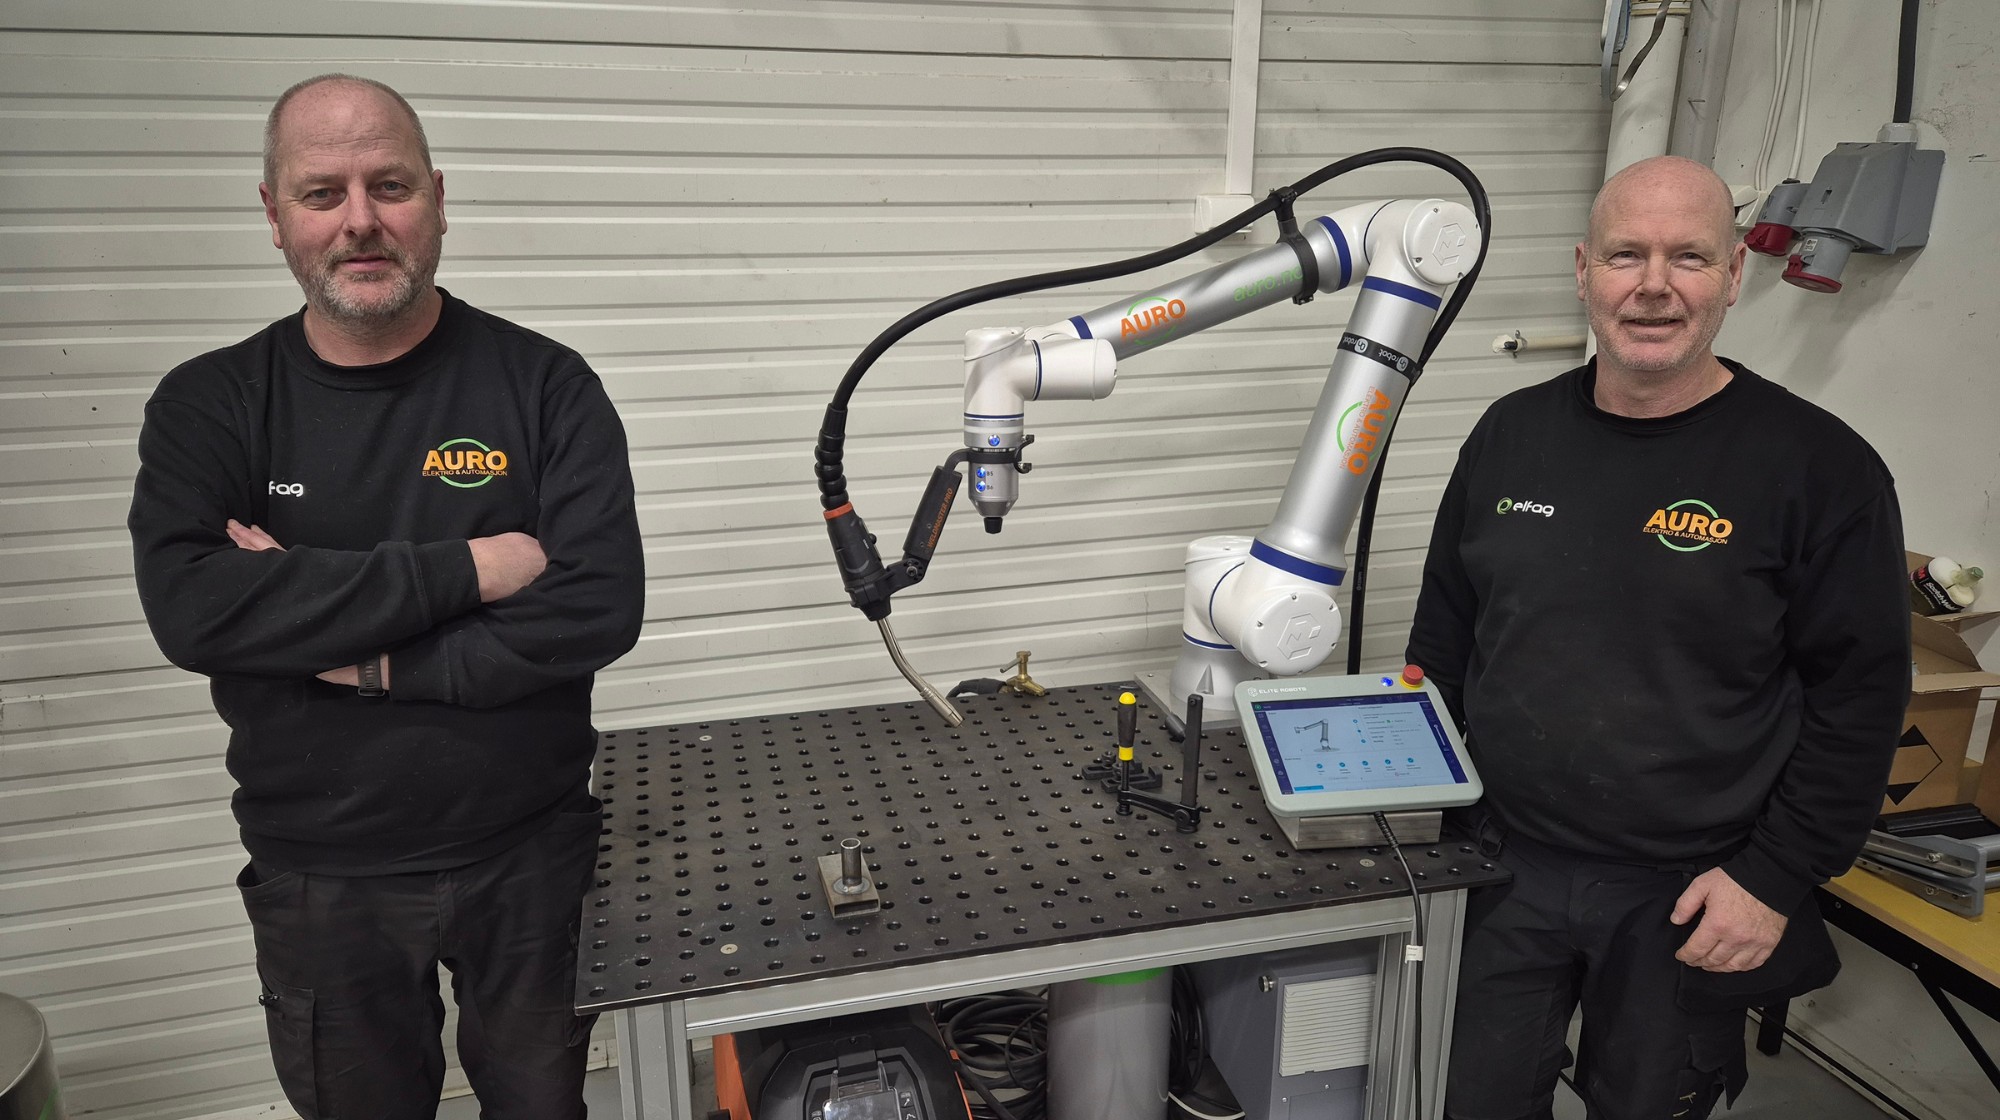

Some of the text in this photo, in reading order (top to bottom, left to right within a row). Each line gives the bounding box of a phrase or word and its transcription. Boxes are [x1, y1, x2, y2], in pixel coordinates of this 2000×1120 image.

[1121, 299, 1186, 339] AURO
[1347, 389, 1392, 475] AURO
[423, 450, 507, 471] AURO
[927, 488, 953, 548] WELDMASTER PRO
[1512, 500, 1555, 518] elfag
[1645, 509, 1733, 538] AURO
[1642, 526, 1674, 537] ELEKTRO
[1680, 532, 1729, 545] AUTOMASJON
